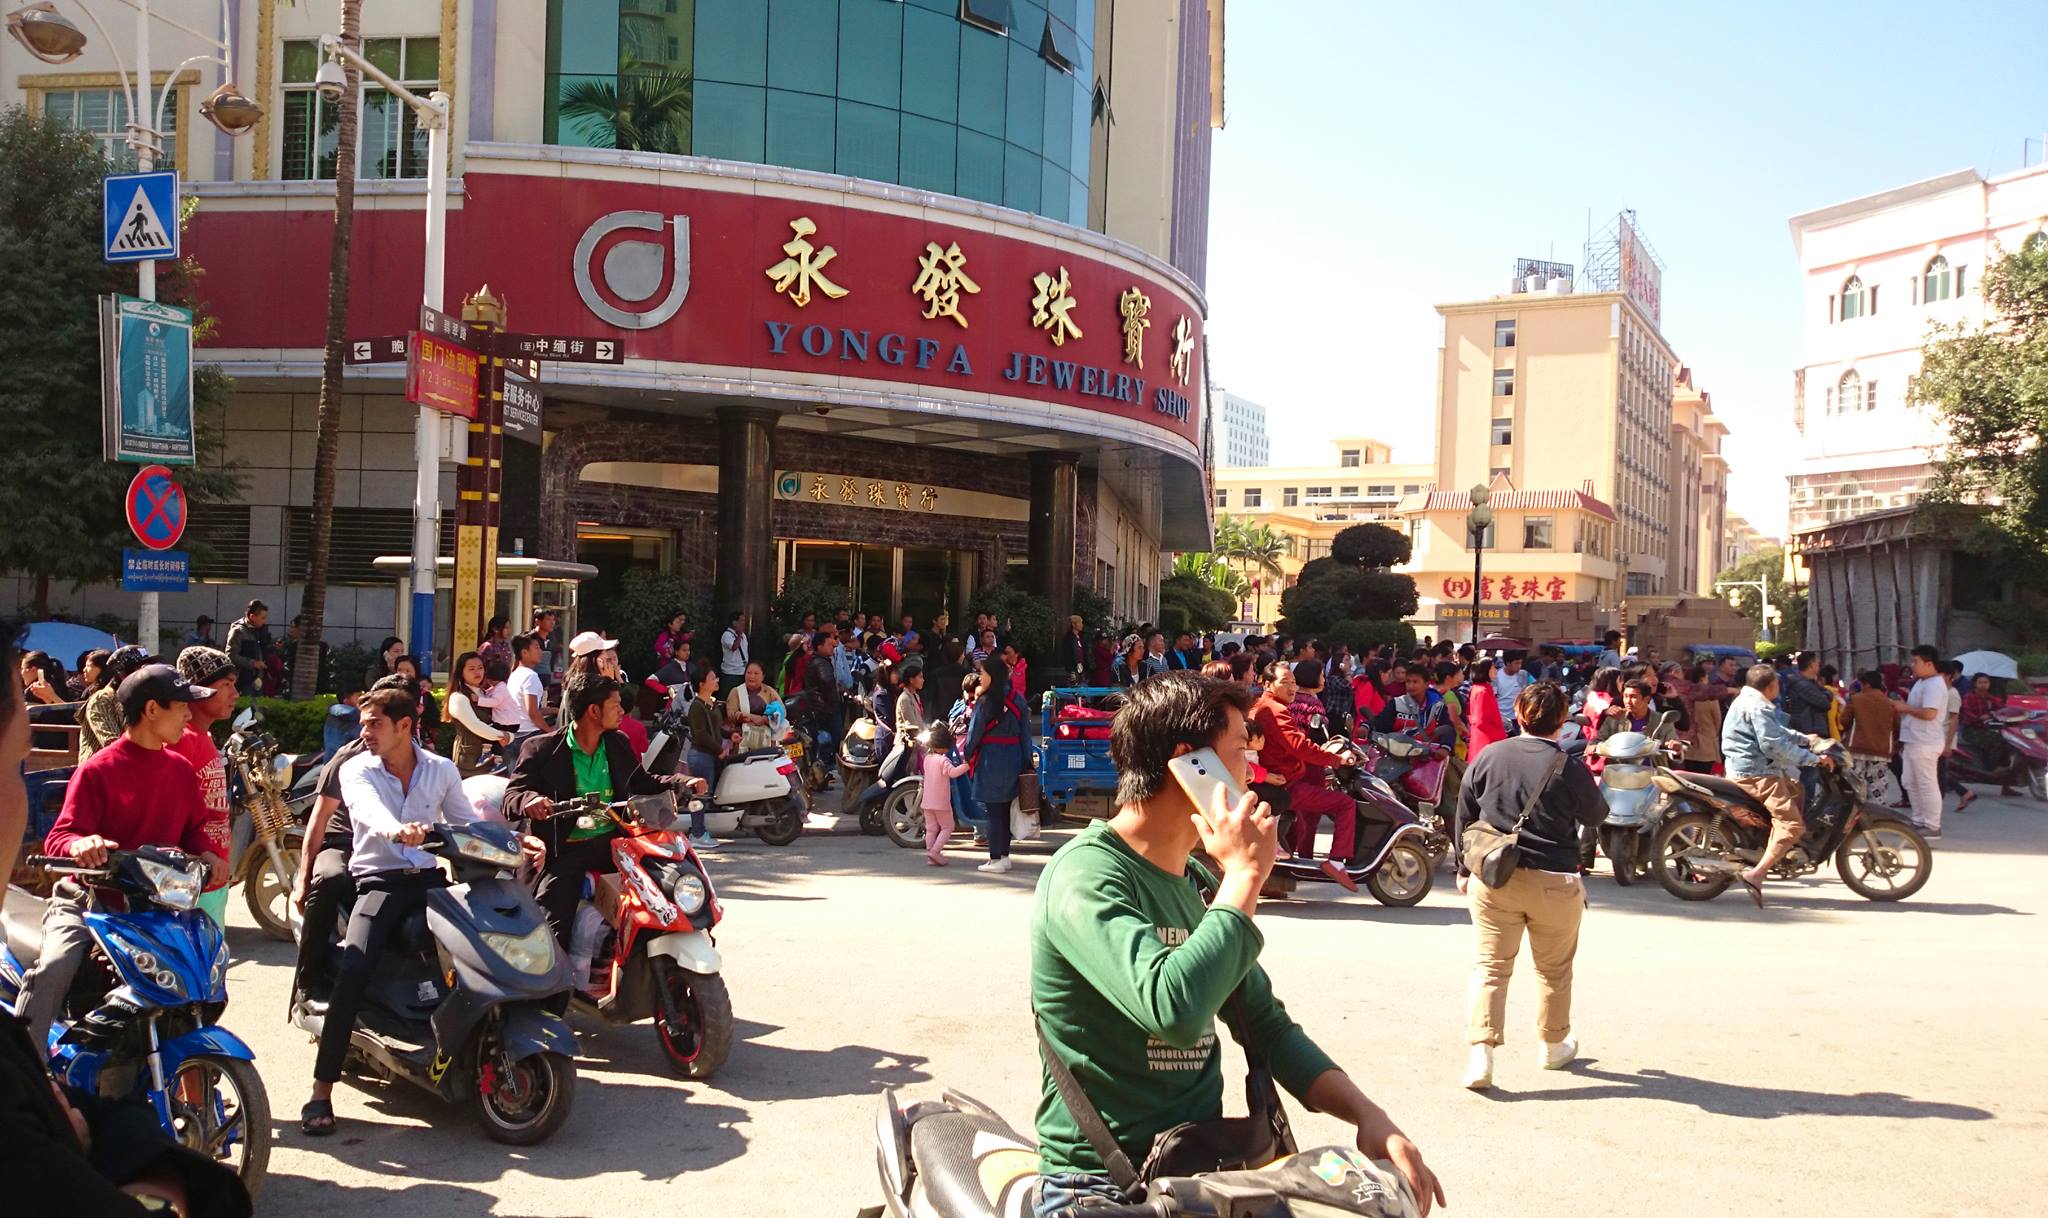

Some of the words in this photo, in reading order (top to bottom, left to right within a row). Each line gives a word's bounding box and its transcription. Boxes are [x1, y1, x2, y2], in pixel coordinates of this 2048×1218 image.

[765, 216, 1195, 388] 永發珠寶行
[764, 321, 974, 376] YONGFA
[1004, 351, 1146, 407] JEWELRY
[1155, 386, 1192, 424] SHOP
[809, 475, 938, 511] 永發珠寶行
[1481, 575, 1566, 601] 富豪珠宝
